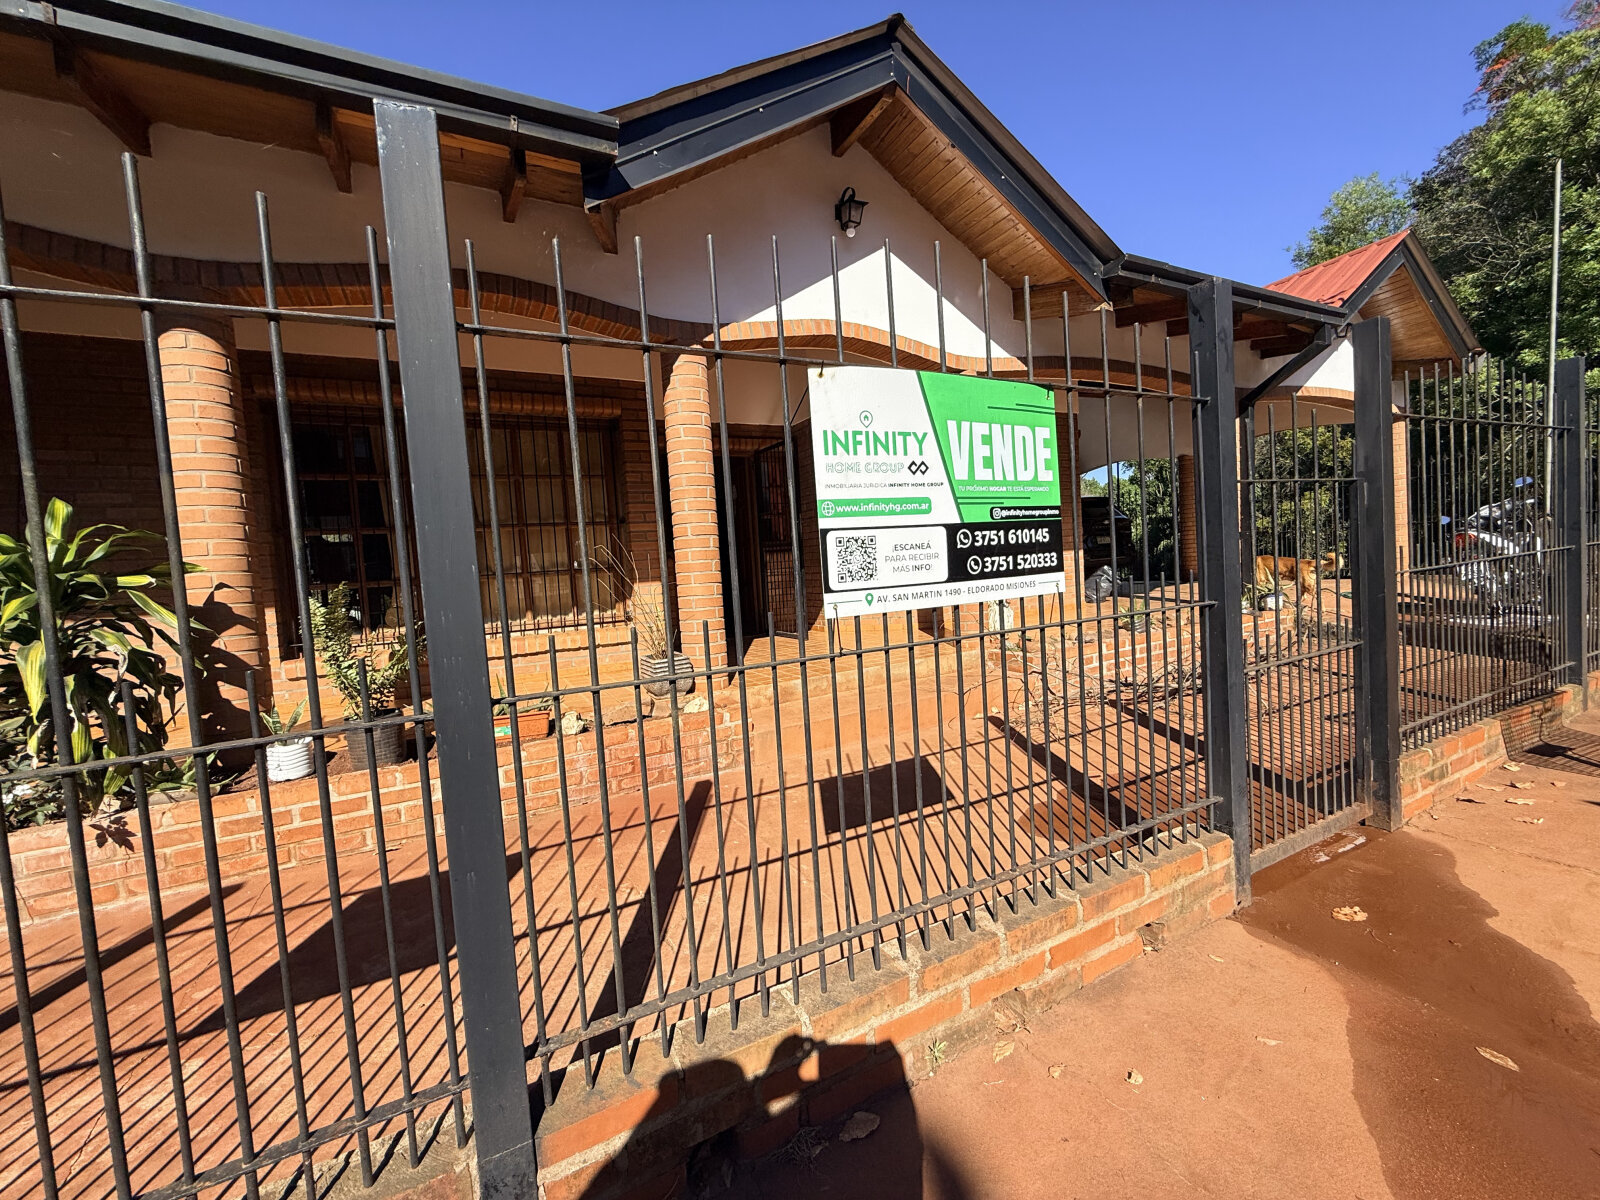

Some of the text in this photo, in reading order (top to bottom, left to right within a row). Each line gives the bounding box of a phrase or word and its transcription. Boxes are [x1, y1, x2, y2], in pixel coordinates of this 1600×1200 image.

[823, 429, 928, 456] INFINITY
[947, 419, 1053, 481] VENDE
[825, 461, 904, 474] HOME GROUP
[836, 503, 930, 514] www.infinityhg.com.ar
[974, 528, 1050, 546] 3751 610145
[885, 552, 940, 563] PARA RECIBIR
[983, 552, 1058, 573] 3751 520333
[876, 594, 891, 604] AV.
[892, 592, 910, 602] SAN
[911, 589, 943, 600] MARTIN
[944, 587, 962, 596] 1490
[967, 582, 1005, 594] ELDORADO
[1006, 580, 1036, 590] MISIONES
